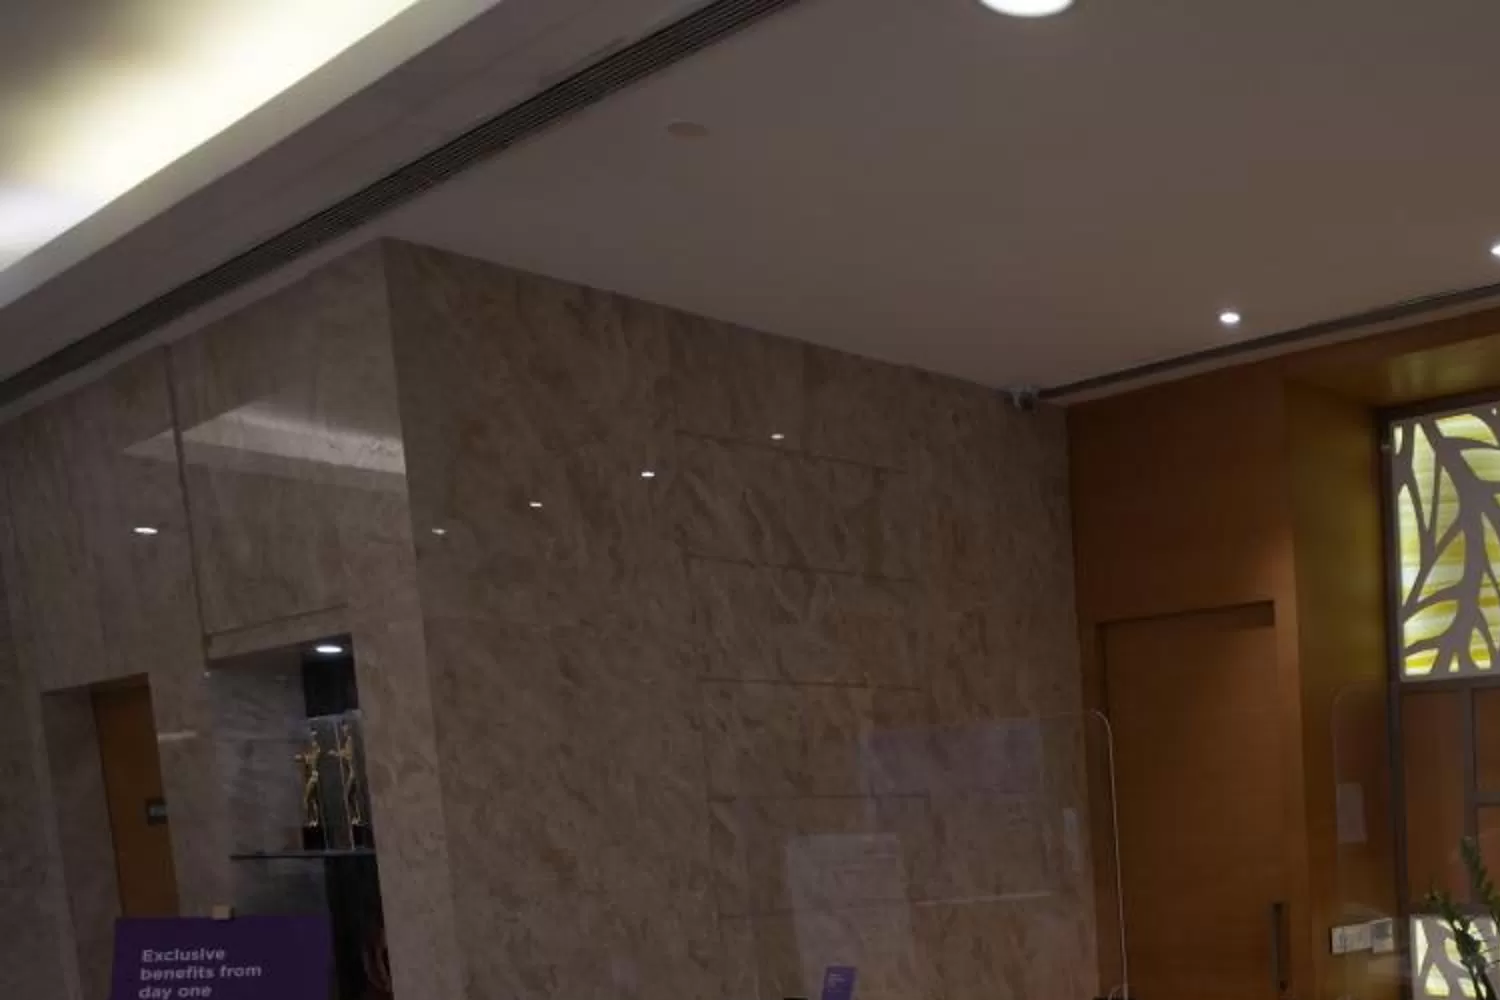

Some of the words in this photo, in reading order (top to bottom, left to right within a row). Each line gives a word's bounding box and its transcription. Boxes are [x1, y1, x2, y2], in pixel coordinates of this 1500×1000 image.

[141, 947, 226, 963] Exclusive
[139, 965, 216, 981] benefits
[219, 964, 263, 978] from
[138, 985, 172, 1000] day
[177, 984, 213, 998] one
